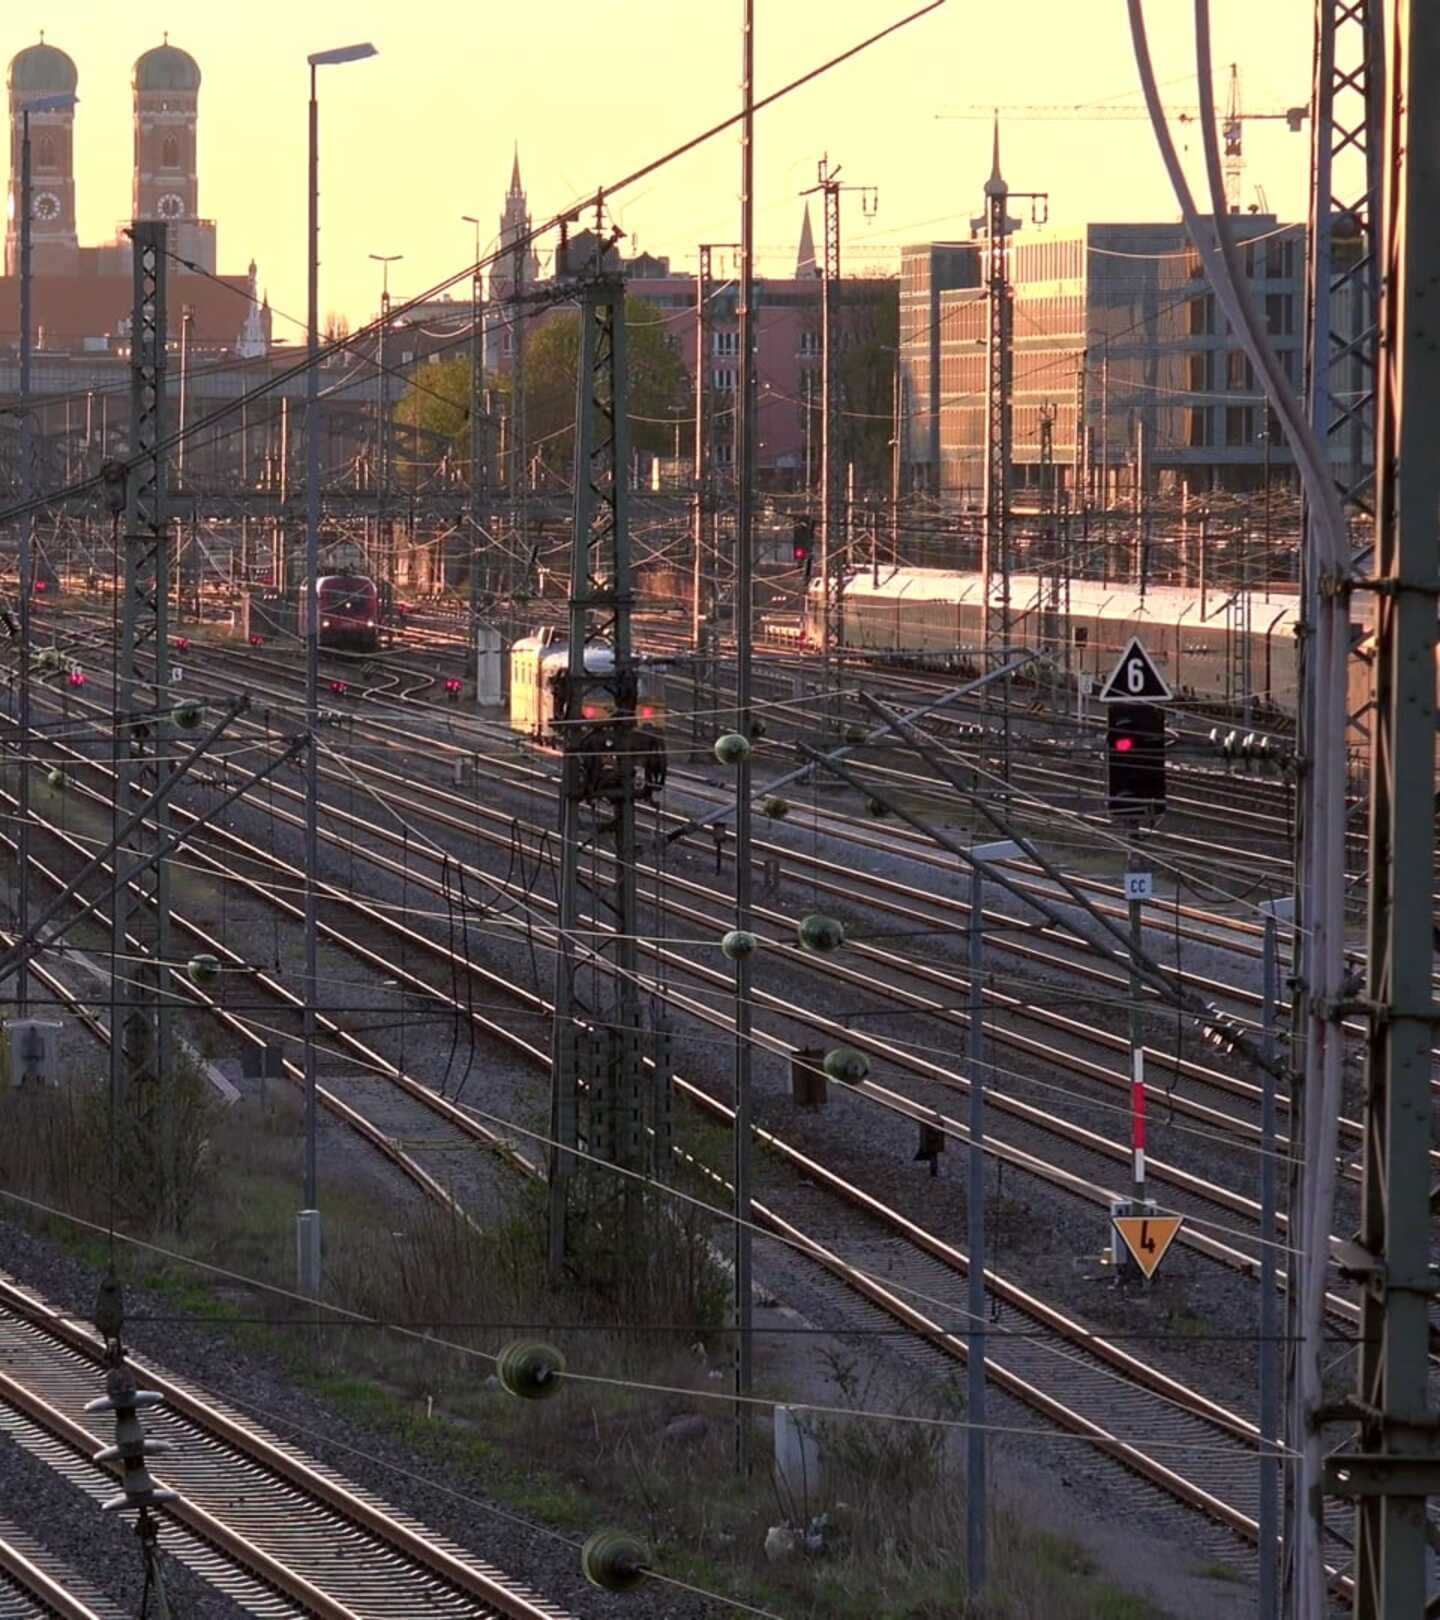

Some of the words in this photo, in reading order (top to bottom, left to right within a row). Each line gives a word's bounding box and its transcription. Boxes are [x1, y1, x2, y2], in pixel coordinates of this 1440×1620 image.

[1127, 658, 1144, 693] 6
[1130, 879, 1146, 893] CC
[1140, 1219, 1156, 1254] 4
